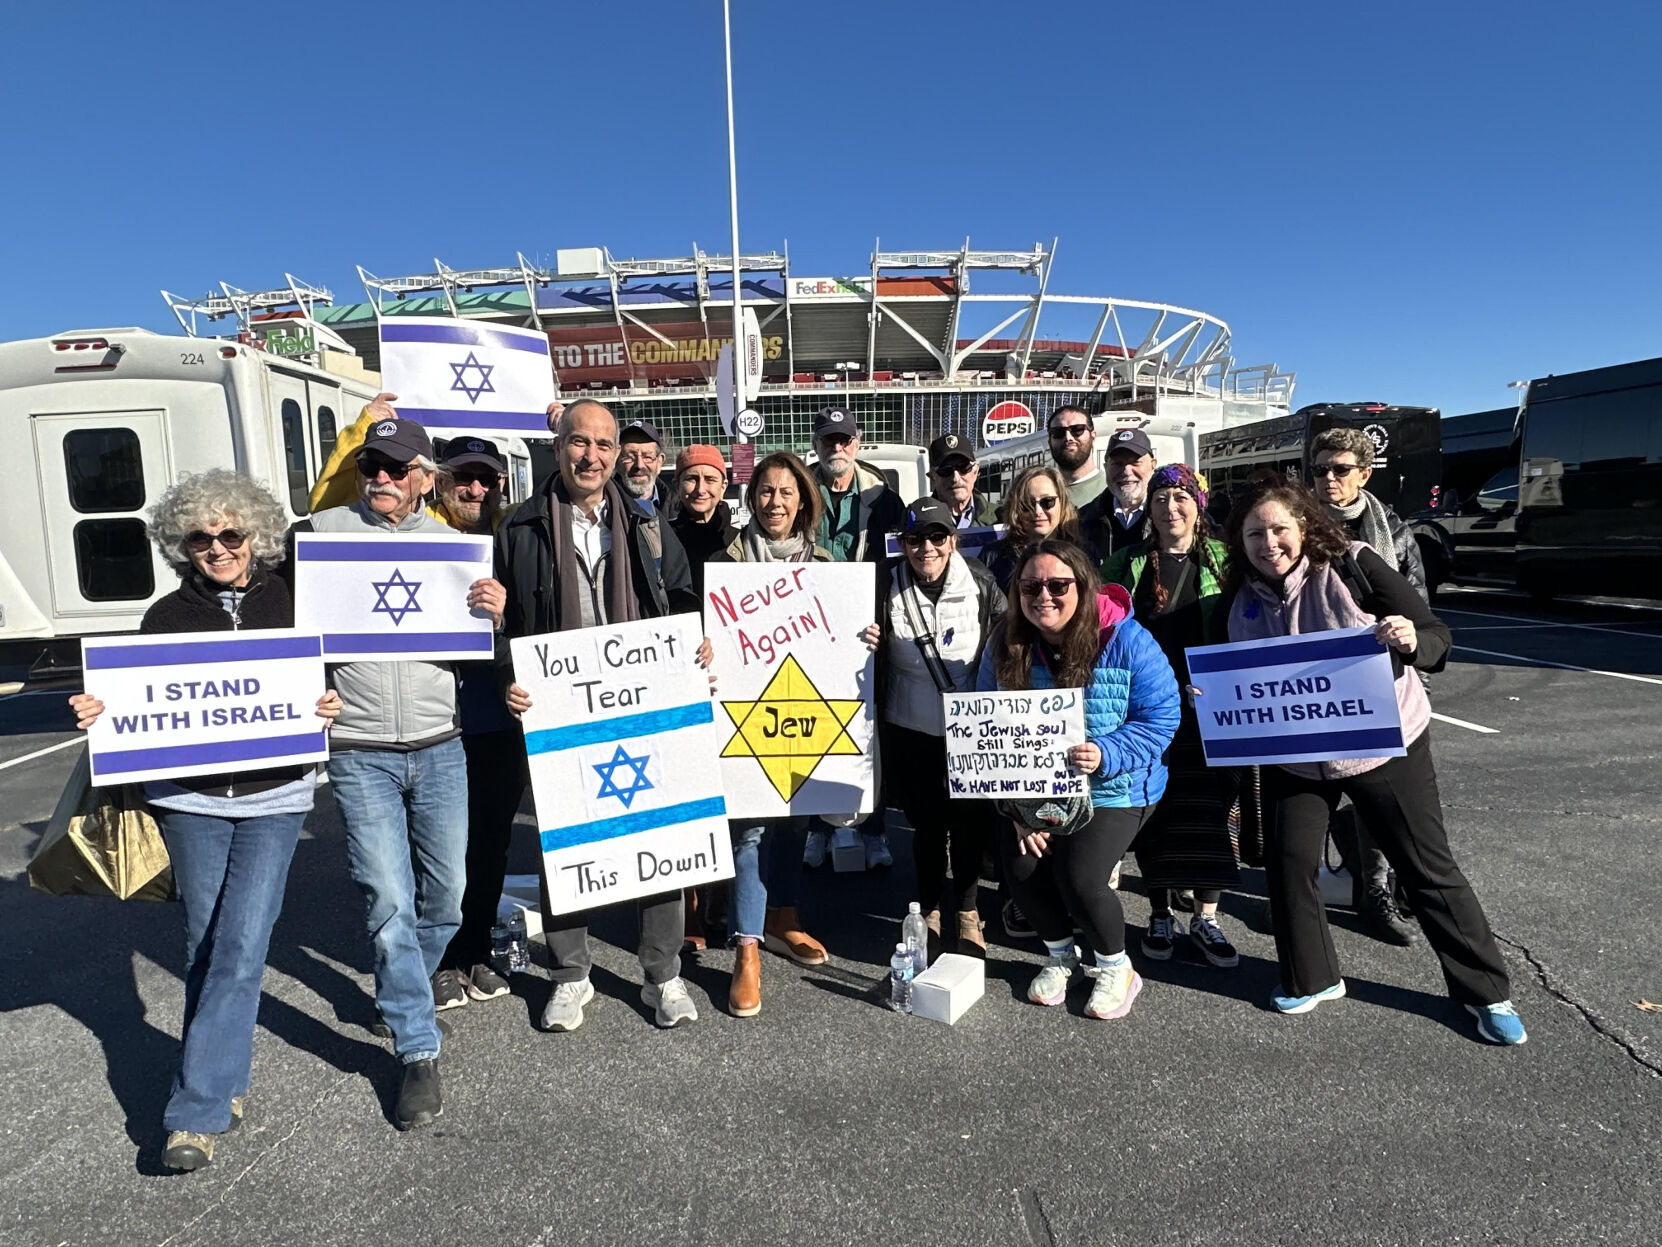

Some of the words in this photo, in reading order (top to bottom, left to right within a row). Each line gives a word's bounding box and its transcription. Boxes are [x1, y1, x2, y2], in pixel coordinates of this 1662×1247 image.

[181, 353, 204, 365] 224
[555, 345, 583, 368] TO
[584, 343, 625, 367] THE
[749, 334, 757, 376] COMMANDERS
[740, 416, 759, 427] H22
[986, 422, 1032, 434] PEPSI
[709, 567, 806, 627] Never
[738, 595, 836, 665] Again!
[534, 643, 580, 678] You
[604, 633, 677, 668] Can't
[146, 685, 153, 702] I
[165, 678, 261, 701] STAND
[572, 680, 648, 713] Tear
[1235, 685, 1243, 700] I
[1250, 676, 1332, 699] STAND
[1040, 691, 1076, 715] נפש
[1213, 706, 1274, 727] WITH
[1282, 699, 1374, 722] ISRAEL
[112, 711, 191, 734] WITH
[202, 703, 301, 727] ISRAEL
[763, 706, 817, 738] Jew
[946, 722, 973, 738] The
[979, 719, 1031, 738] Jewish
[977, 739, 1004, 751] Still
[1054, 769, 1076, 780] OUR
[969, 780, 997, 793] HAVE
[1000, 780, 1020, 792] NOT
[1023, 780, 1047, 793] LOST
[1052, 780, 1083, 795] HOPE
[561, 861, 618, 894] This
[637, 832, 718, 882] Down!
